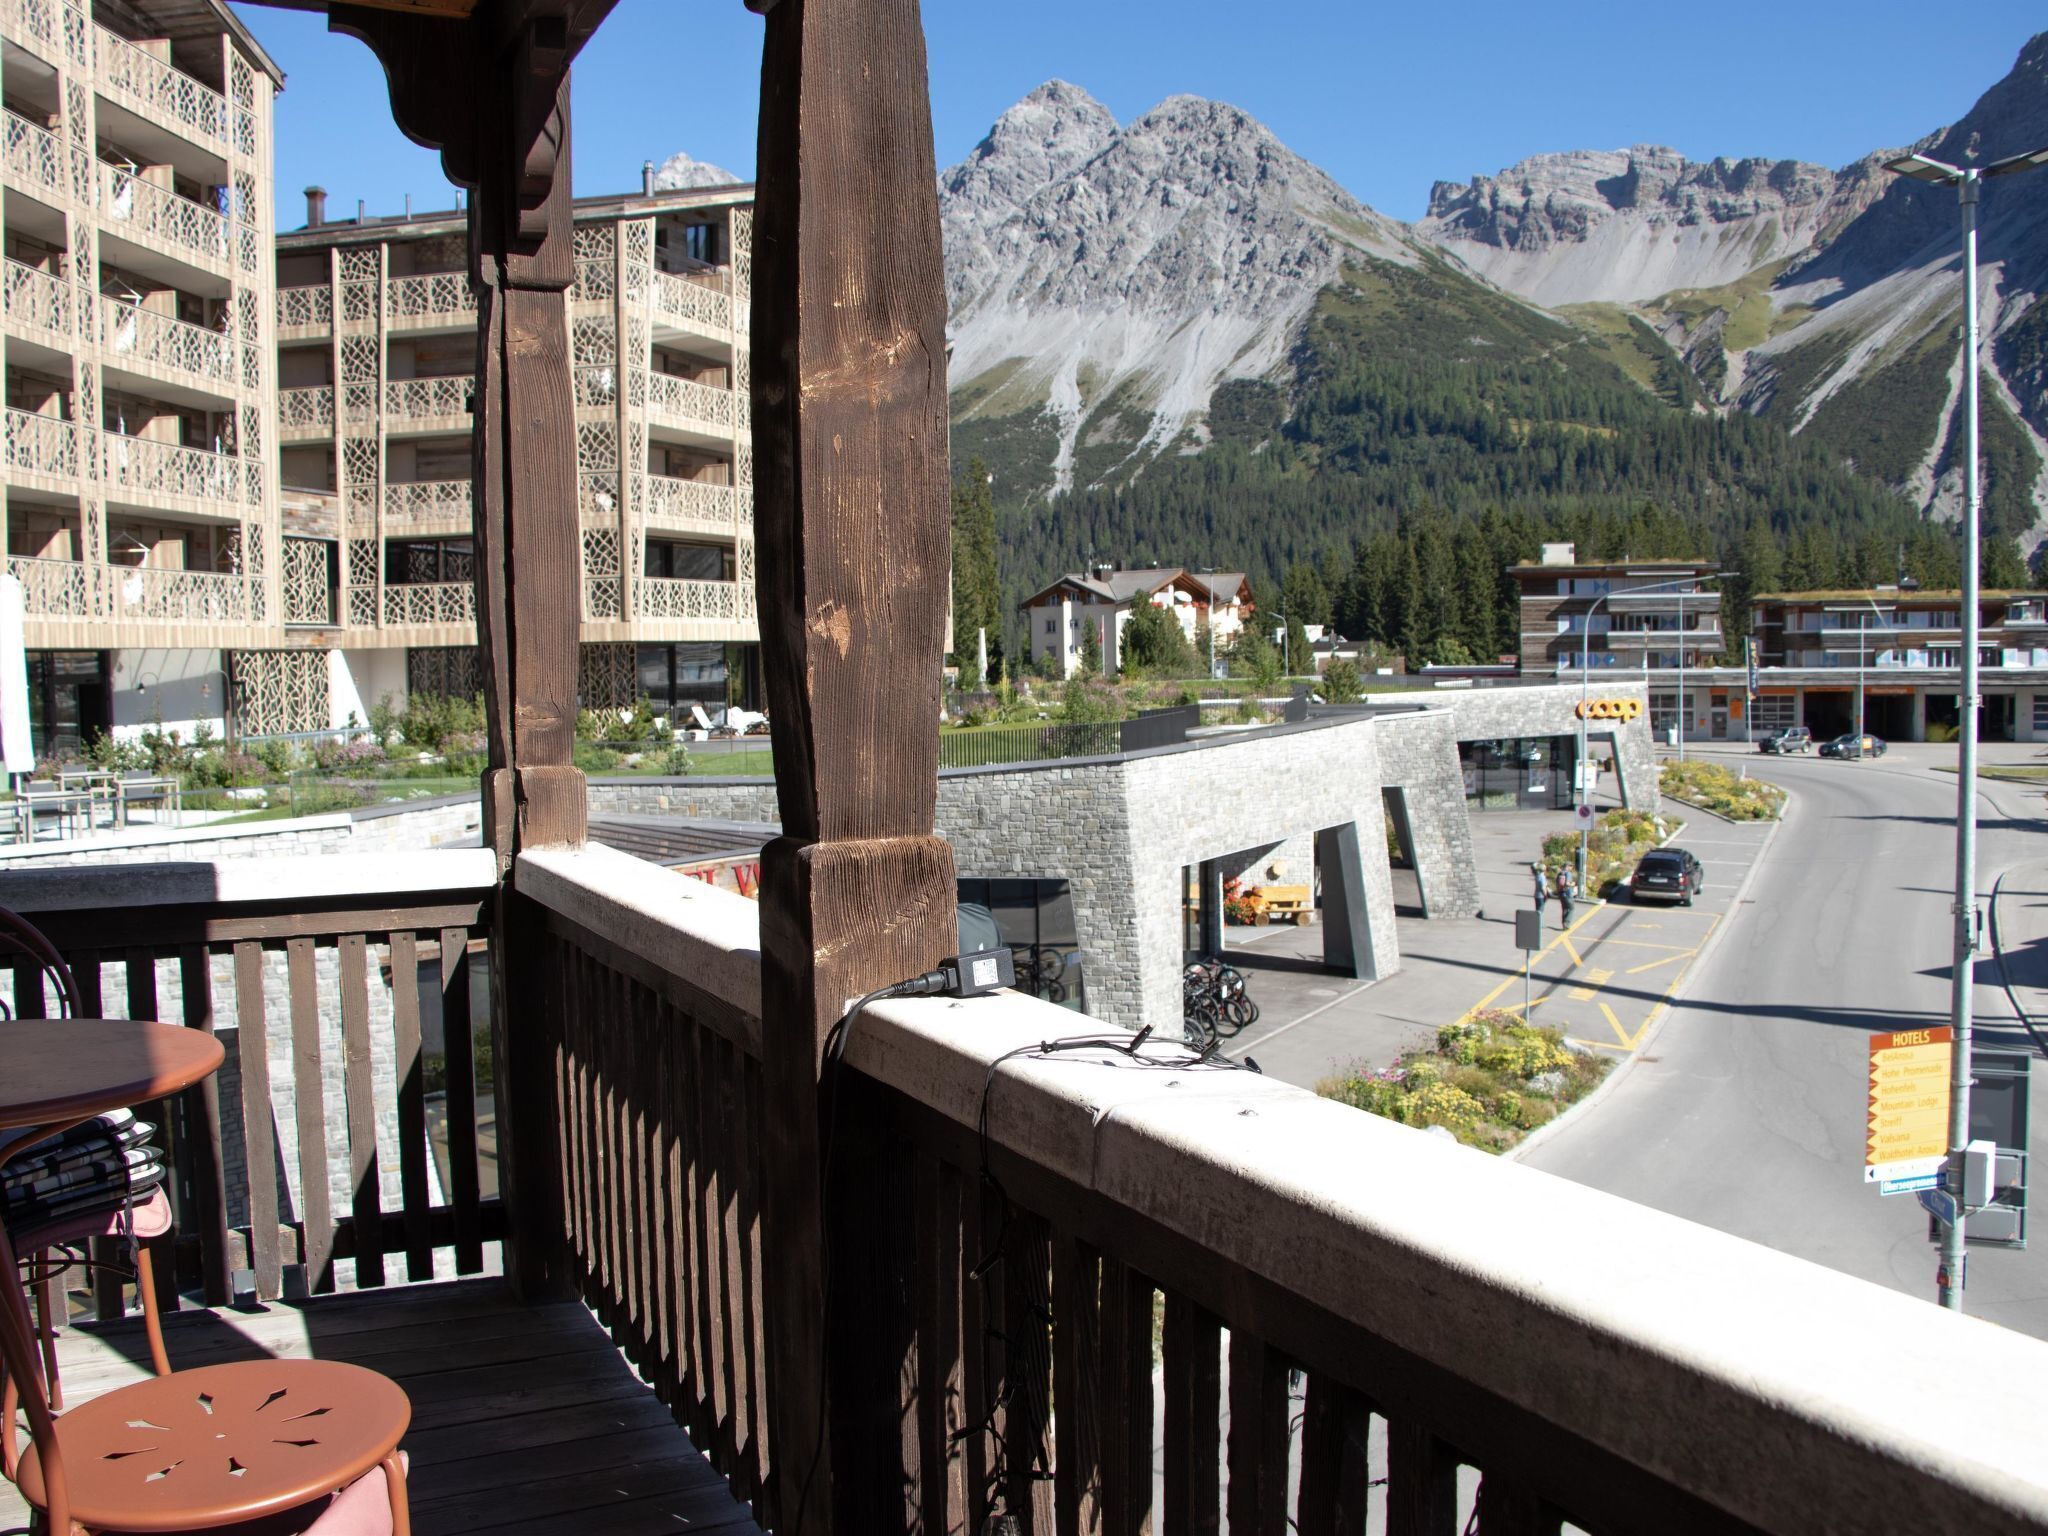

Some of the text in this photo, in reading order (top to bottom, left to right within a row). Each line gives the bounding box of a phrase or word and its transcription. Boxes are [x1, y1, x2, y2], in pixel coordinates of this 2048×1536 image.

[1576, 698, 1643, 724] coop
[1892, 1030, 1930, 1047] HOTELS
[1903, 1063, 1942, 1076] Promenade
[1881, 1082, 1917, 1096] Hohenfels
[1880, 1096, 1938, 1111] Mountain Lodge
[1879, 1133, 1910, 1144] Valsana
[1879, 1145, 1938, 1160] Waldhotel Arosa
